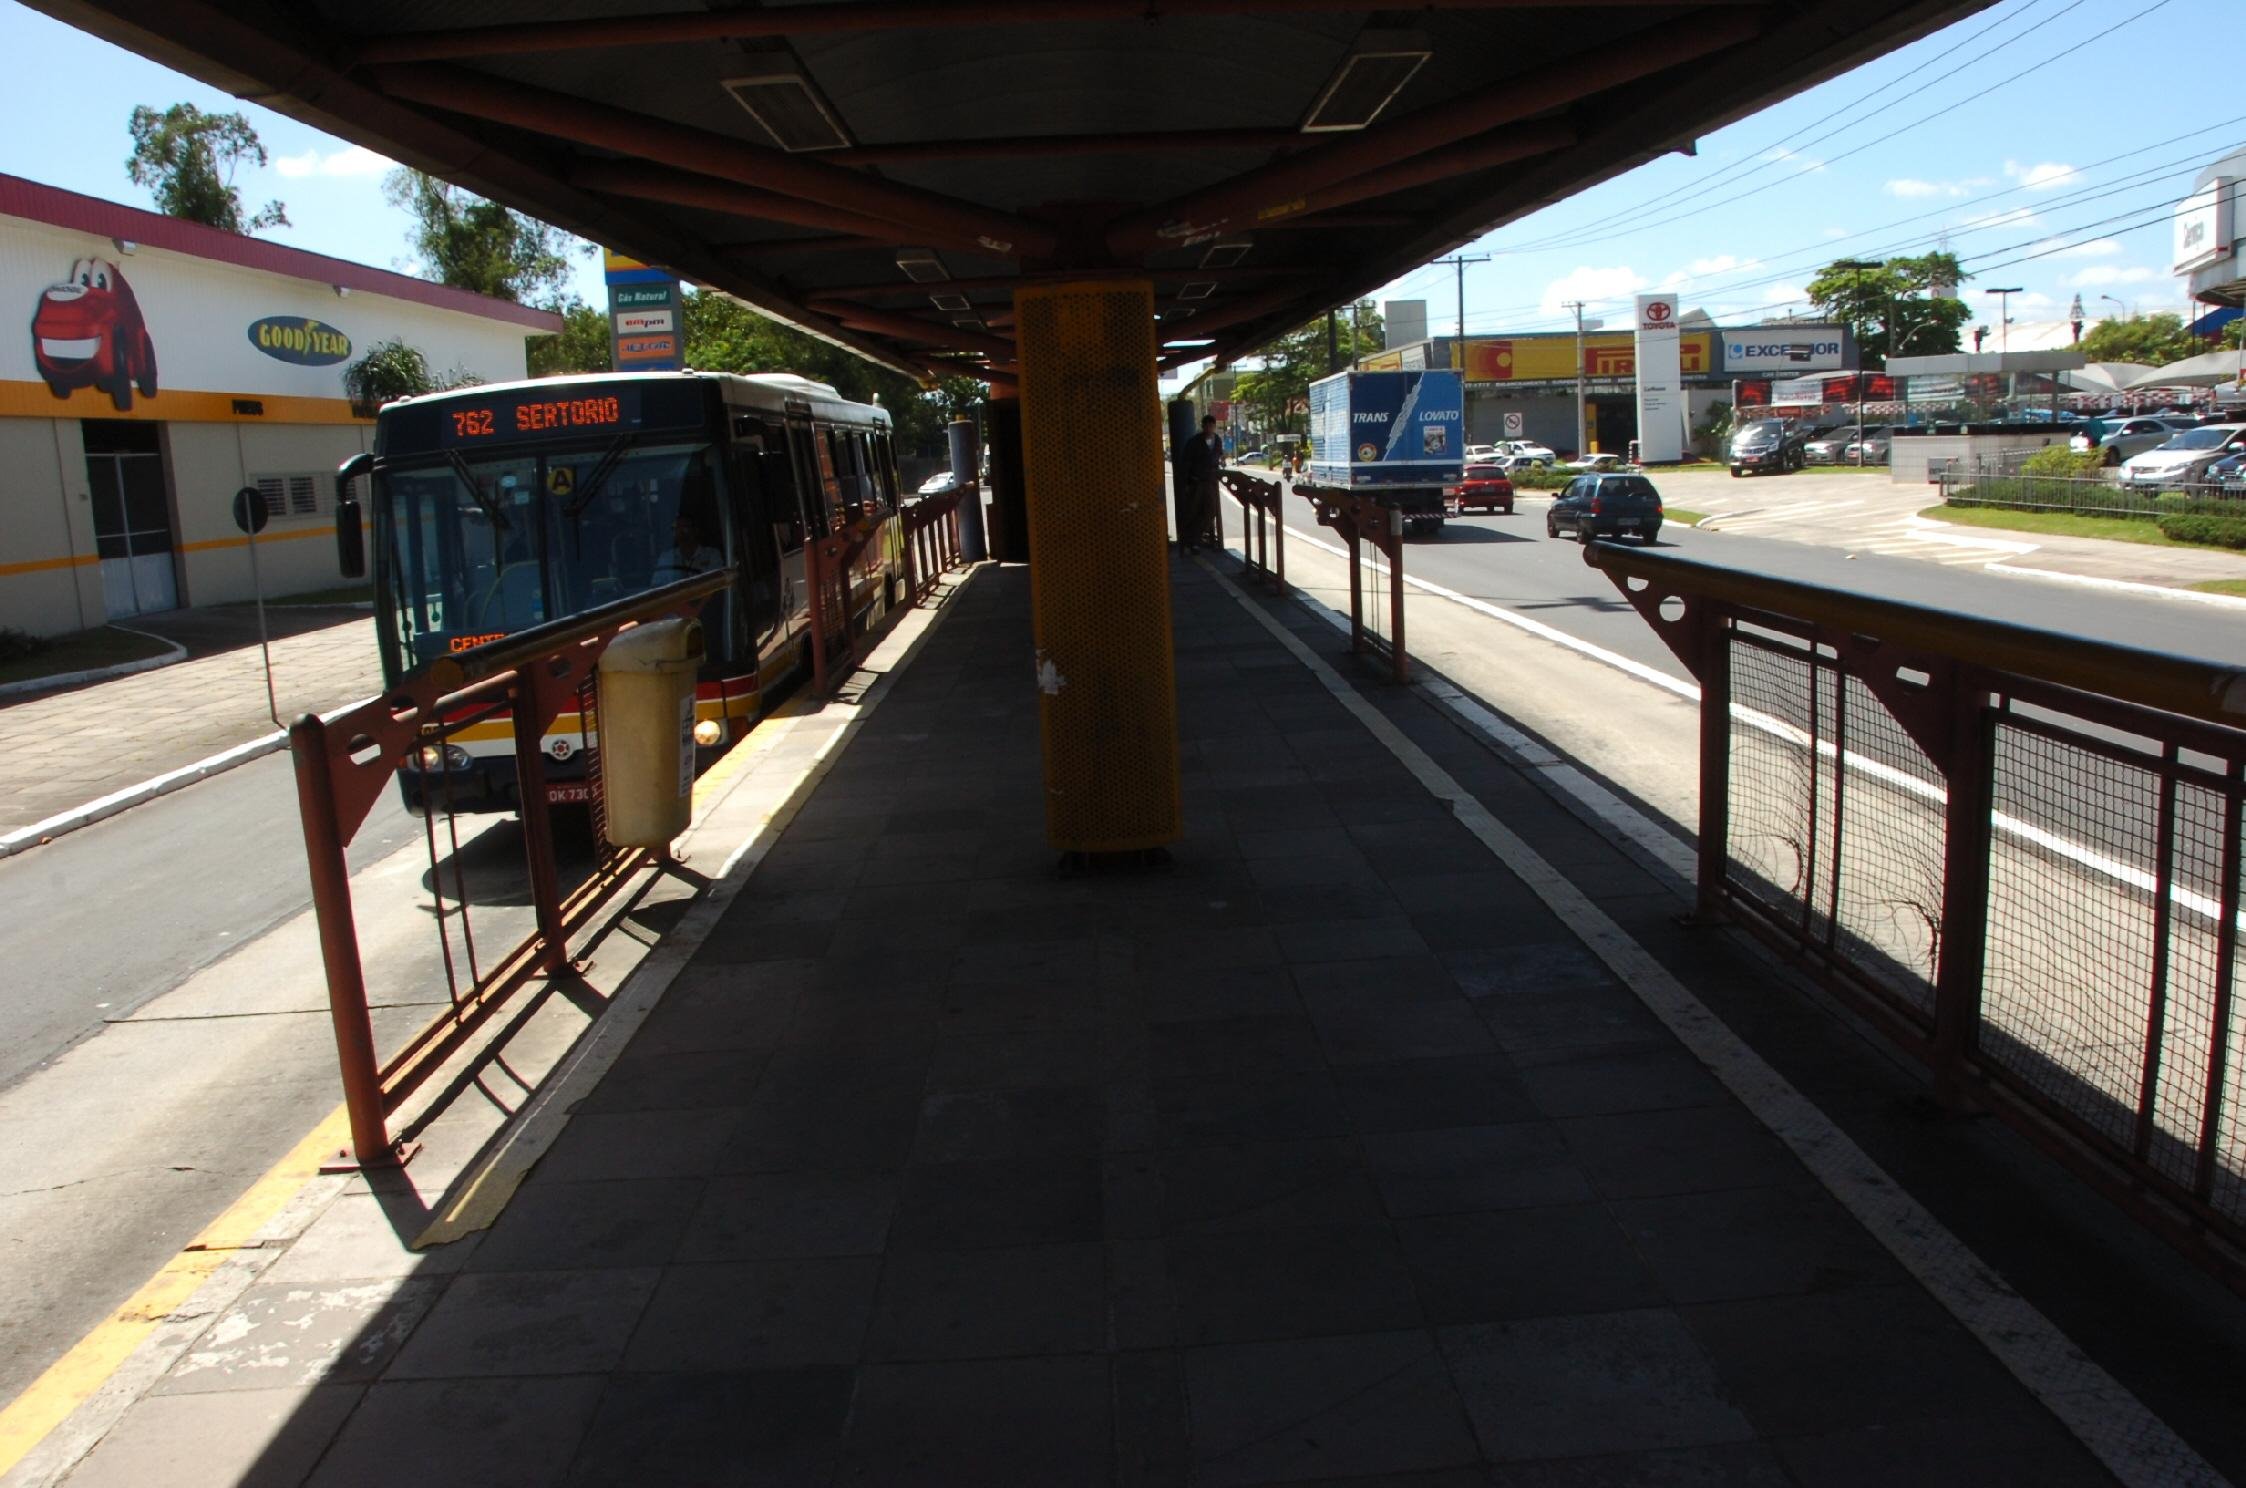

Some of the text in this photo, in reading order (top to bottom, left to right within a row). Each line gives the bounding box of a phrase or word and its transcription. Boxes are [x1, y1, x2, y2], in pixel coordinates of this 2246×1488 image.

[634, 290, 667, 301] Natural
[1642, 321, 1676, 331] TOYOTA
[258, 322, 348, 357] GOODYEAR
[1745, 342, 1839, 357] EXCEIOR
[453, 397, 619, 436] 762 SERTORIO
[1353, 410, 1459, 423] TRANS LOVATO
[552, 469, 571, 491] A
